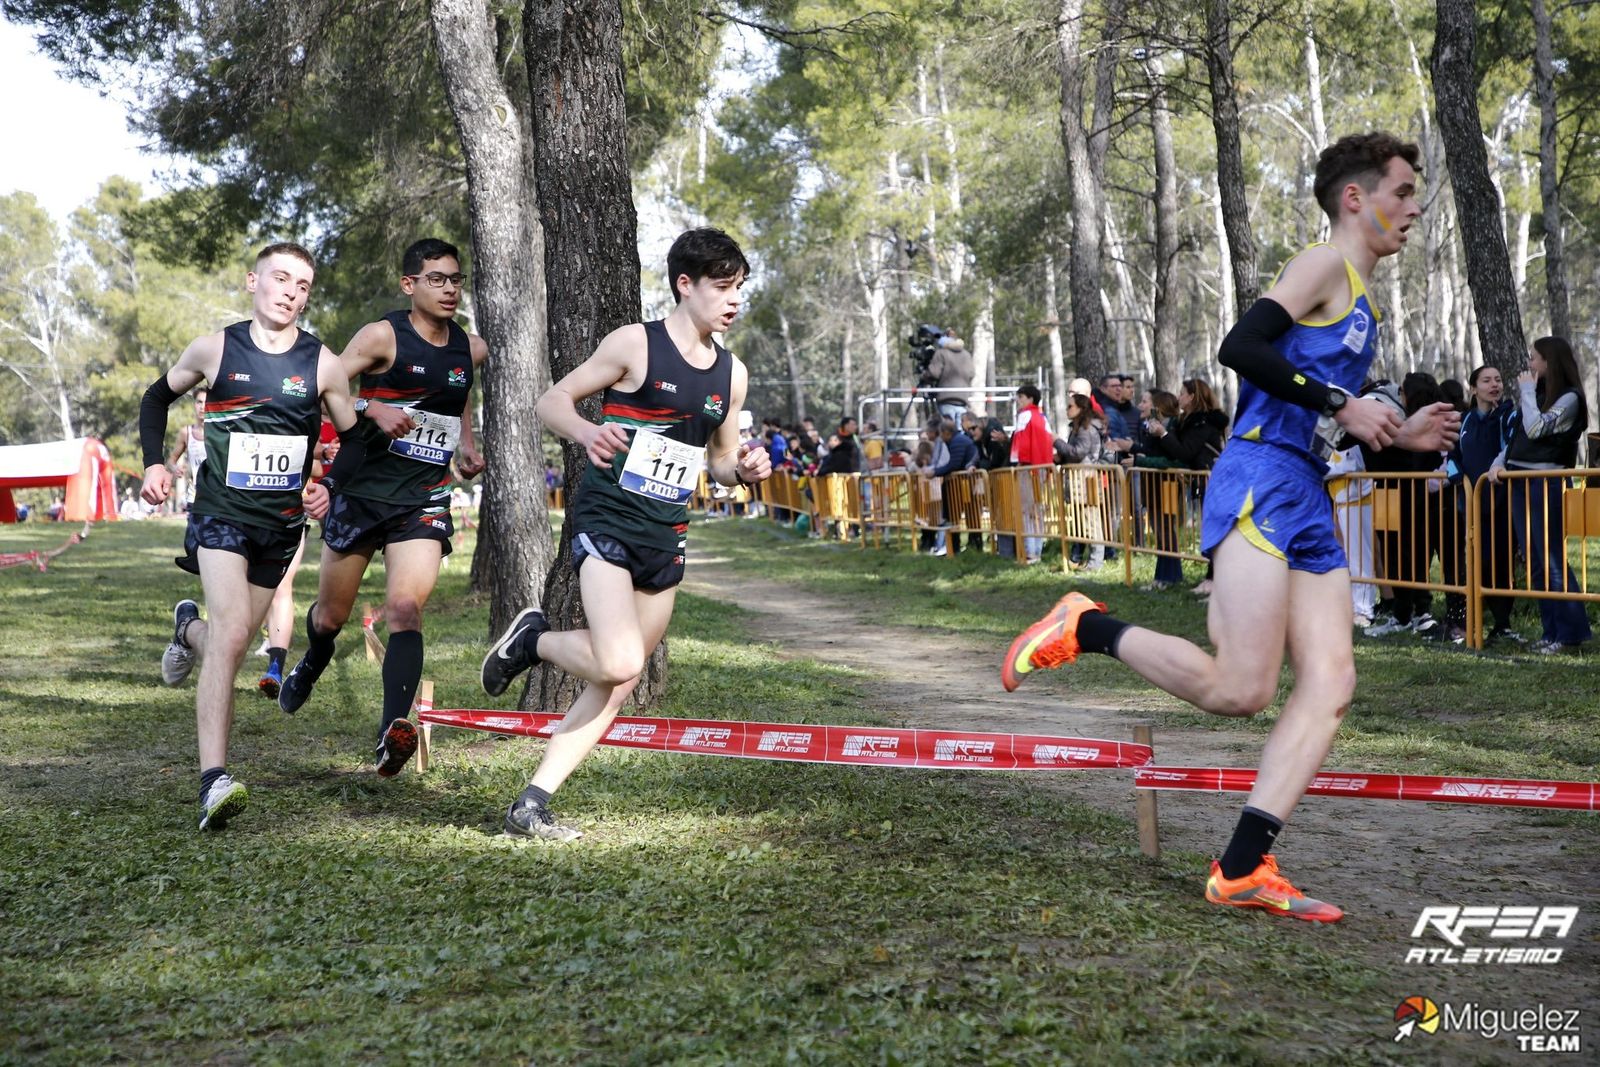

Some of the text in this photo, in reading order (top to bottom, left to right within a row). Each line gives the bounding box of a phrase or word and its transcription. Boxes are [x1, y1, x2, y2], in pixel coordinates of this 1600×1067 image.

[415, 427, 448, 448] 114
[251, 453, 290, 473] 110
[652, 458, 688, 484] 111
[627, 723, 657, 737] RFEA
[699, 727, 732, 741] RFEA
[778, 732, 812, 746] RFEA
[862, 736, 900, 751] RFEA
[954, 740, 995, 755] RFEA
[1053, 746, 1100, 761] RFEA
